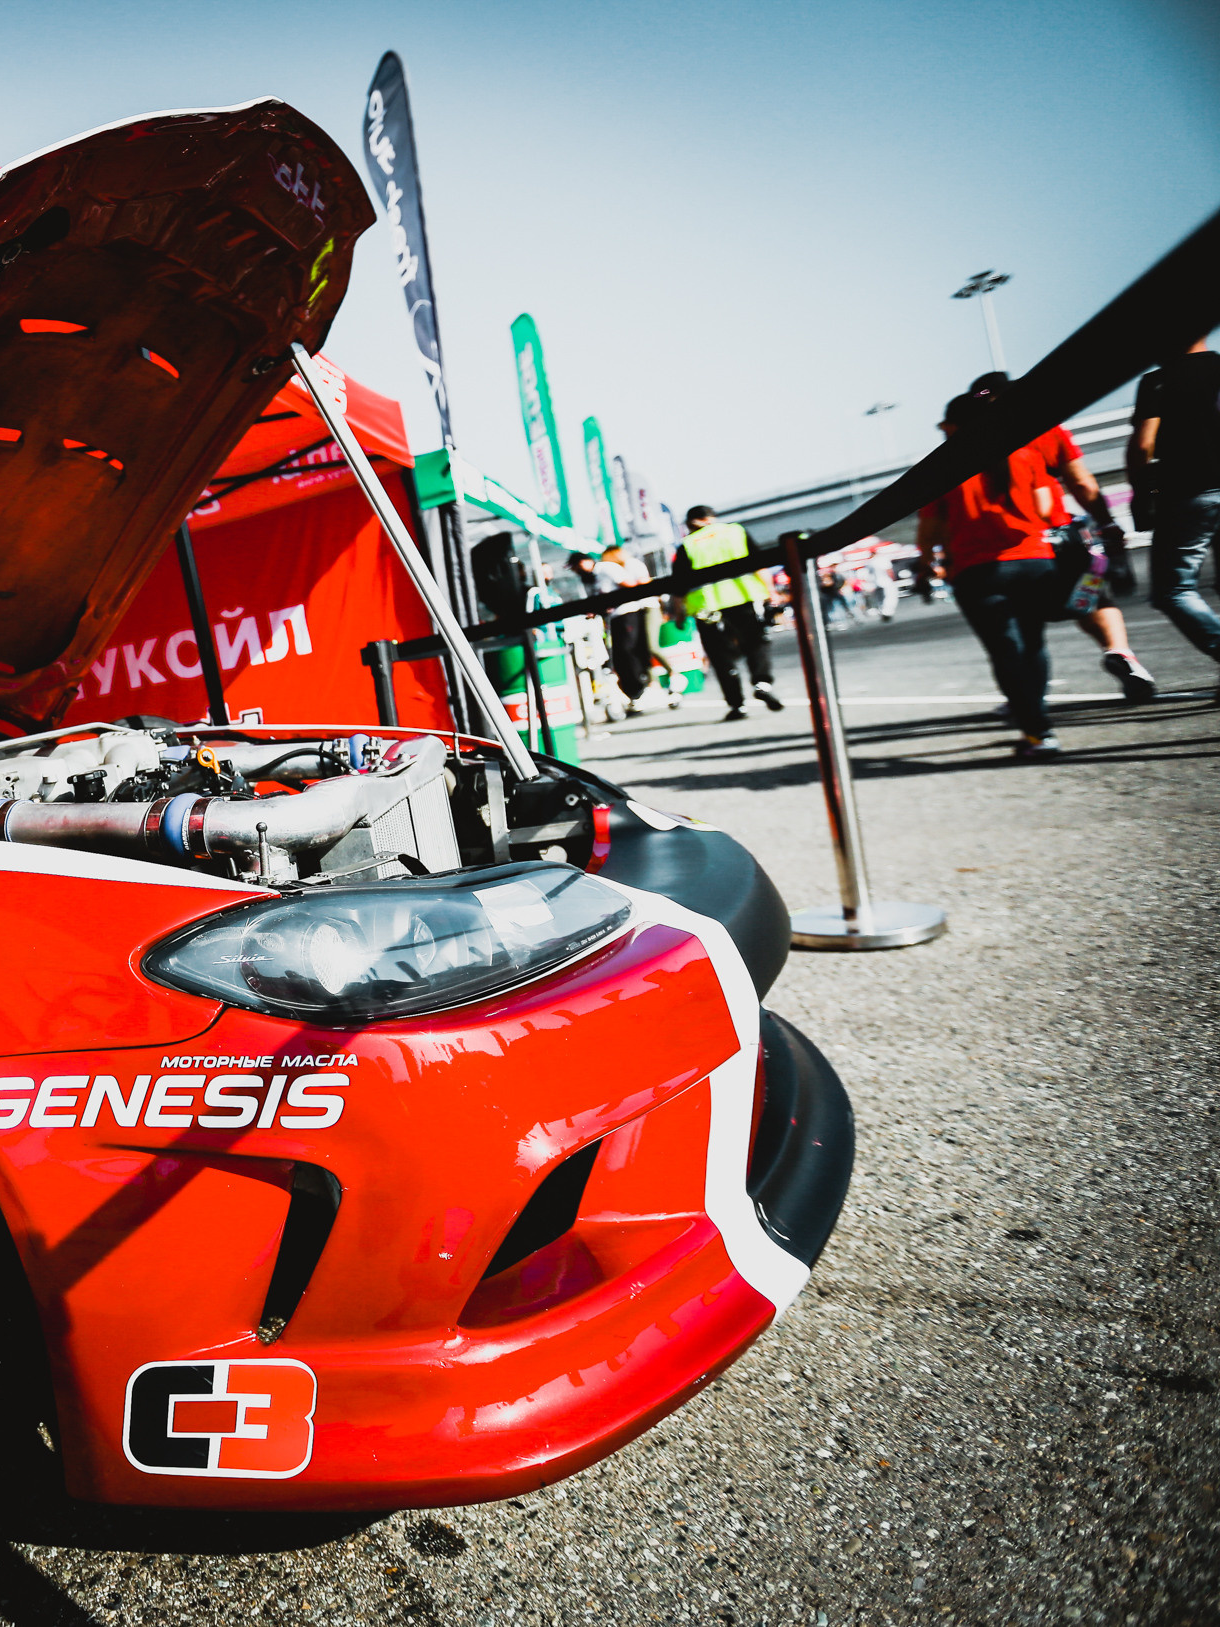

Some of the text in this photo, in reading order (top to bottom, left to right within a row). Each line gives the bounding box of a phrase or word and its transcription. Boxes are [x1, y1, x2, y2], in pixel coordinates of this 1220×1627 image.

[75, 603, 313, 701] УКОЙЛ
[212, 953, 275, 965] Silvia
[160, 1053, 359, 1069] МОТОРНЫЕ МАСЛА
